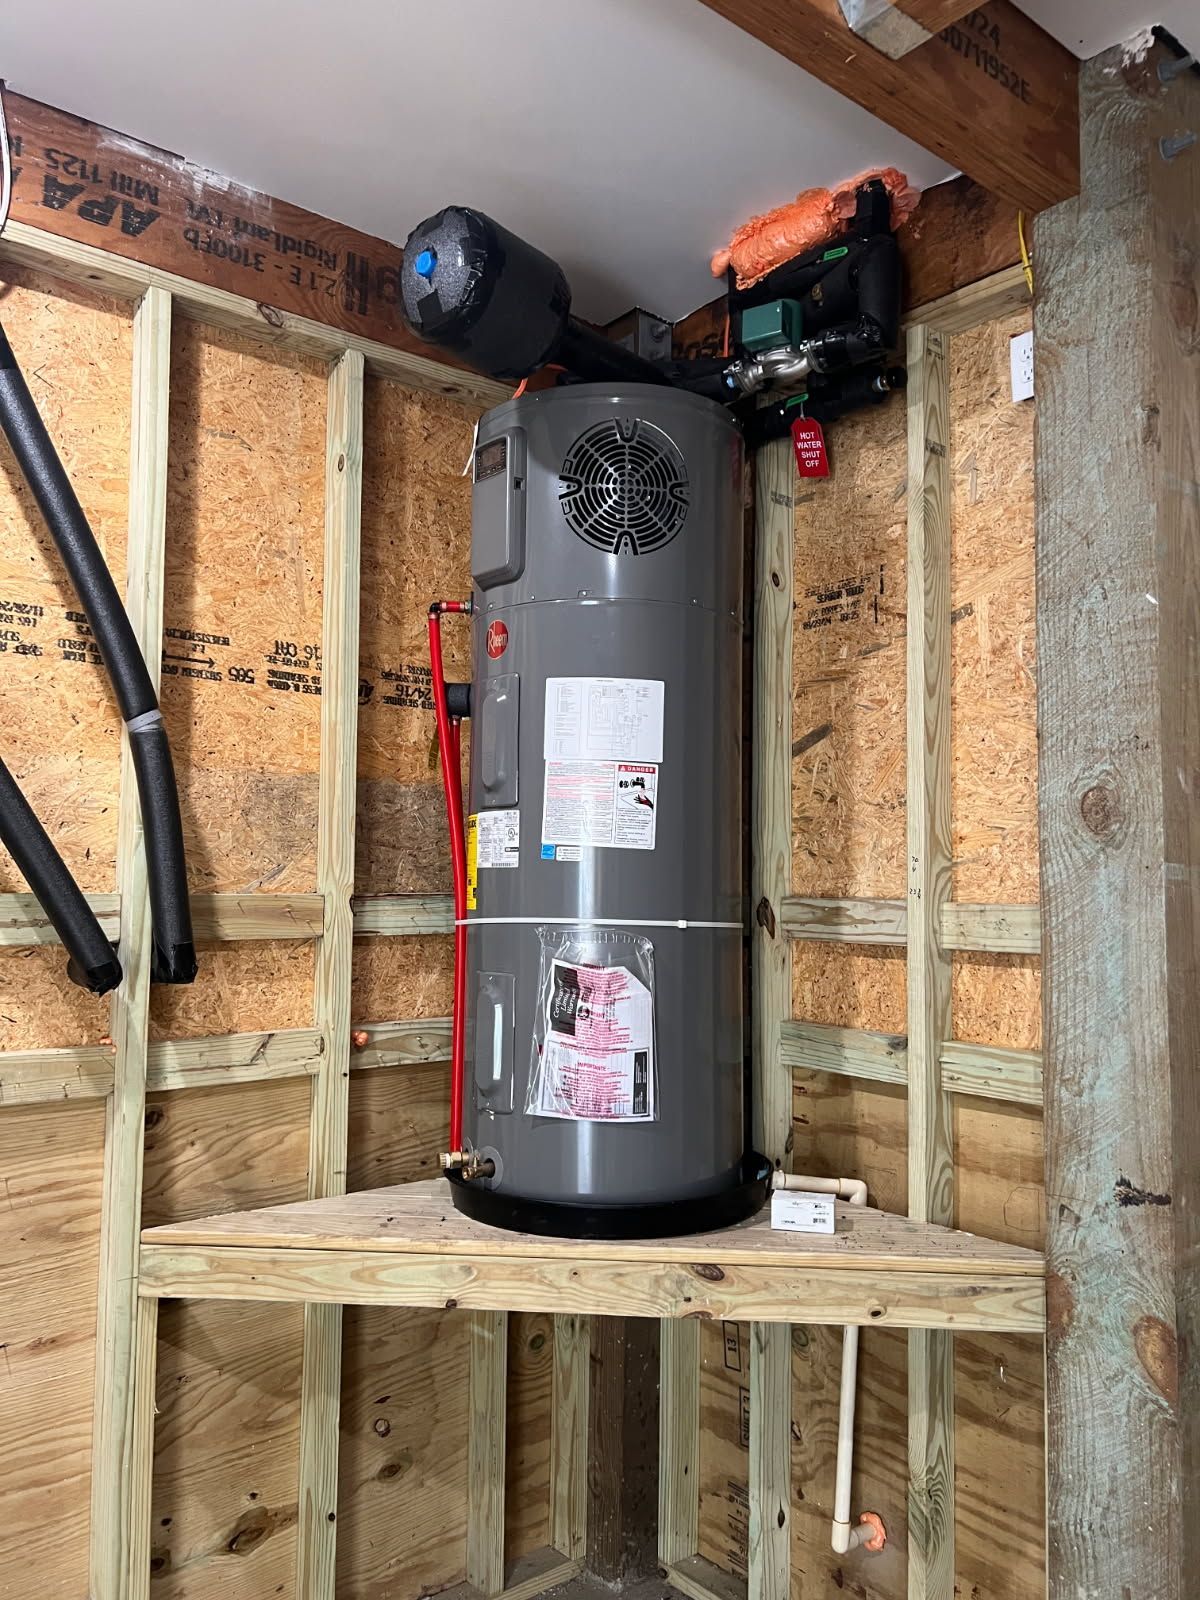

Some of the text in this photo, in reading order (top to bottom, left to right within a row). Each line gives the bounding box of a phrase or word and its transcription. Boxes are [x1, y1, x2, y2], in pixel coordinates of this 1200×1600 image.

[43, 147, 103, 184] 1125
[110, 171, 160, 206] Mill
[42, 172, 161, 237] APA
[800, 431, 815, 440] HOT
[796, 440, 822, 449] WATER
[801, 450, 820, 459] SHUT
[805, 459, 820, 468] OFF
[274, 640, 322, 661] 16 CAT
[395, 683, 432, 701] 24/16
[726, 1337, 737, 1353] 13
